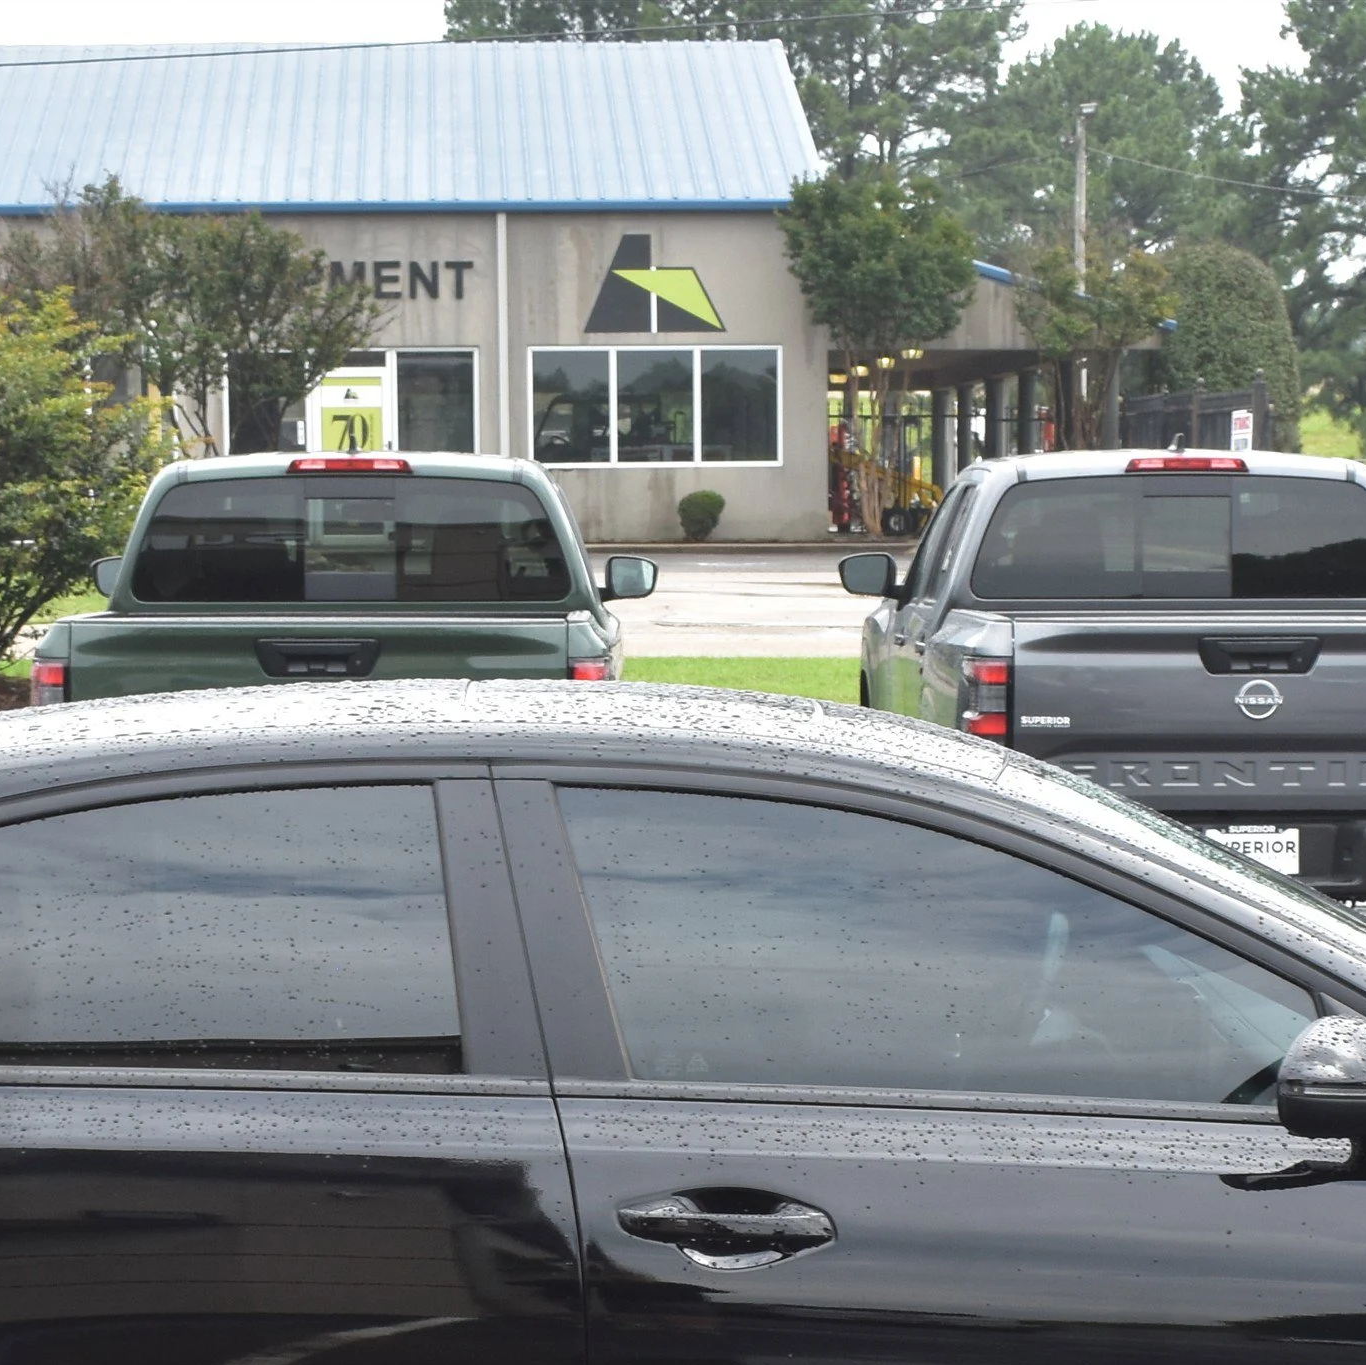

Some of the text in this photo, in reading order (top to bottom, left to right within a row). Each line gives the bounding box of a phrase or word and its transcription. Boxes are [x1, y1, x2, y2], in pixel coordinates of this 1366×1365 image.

[1234, 696, 1284, 705] NISSAN
[1020, 715, 1071, 725] SUPERIOR
[1228, 825, 1276, 833] SUPERIOR
[1226, 841, 1296, 854] PERIOR
